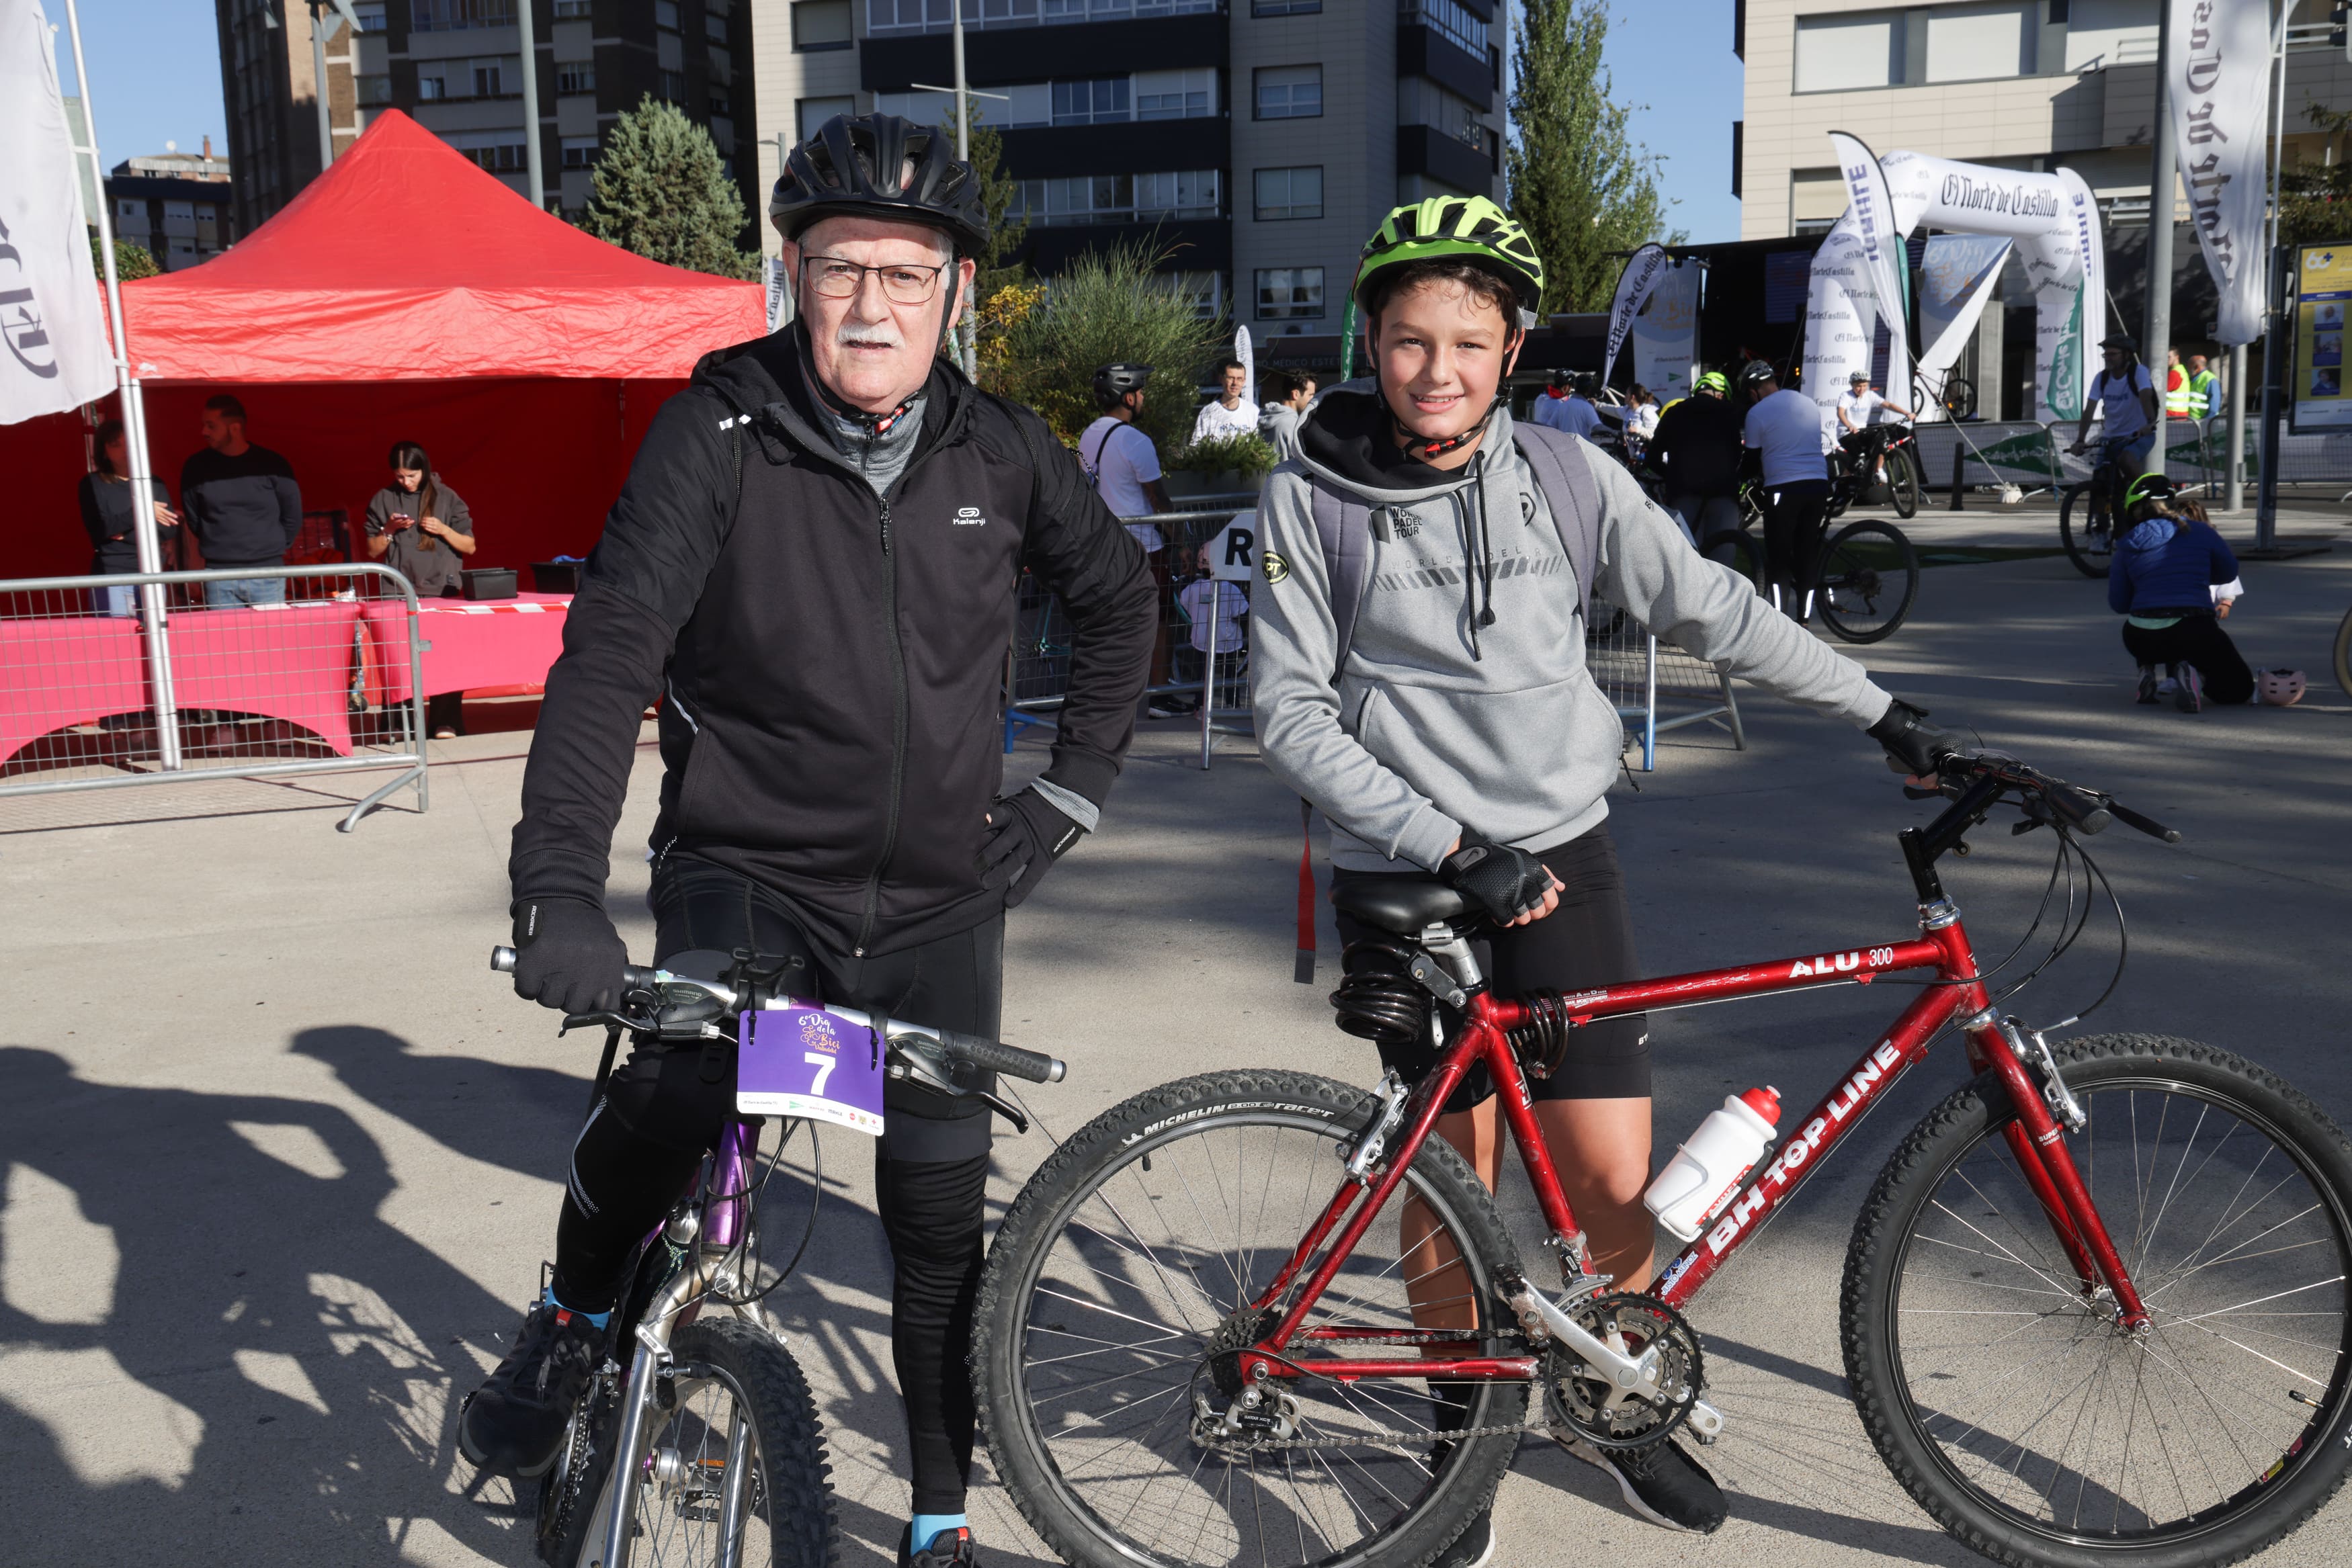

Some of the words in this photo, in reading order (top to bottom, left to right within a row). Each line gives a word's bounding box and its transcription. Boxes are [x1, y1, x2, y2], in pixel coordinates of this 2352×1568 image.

[1941, 173, 1959, 206] El
[1960, 175, 1996, 212] Norte
[1997, 184, 2011, 213] de
[2011, 185, 2058, 218] Castilla
[1612, 305, 1633, 337] Norte
[1625, 291, 1638, 306] de
[1633, 250, 1665, 293] Castilla
[953, 518, 986, 527] Kalenji
[1393, 517, 1423, 529] PADEL
[1394, 527, 1419, 539] TOUR
[1225, 528, 1254, 566] R
[1789, 952, 1859, 978] ALU
[1870, 947, 1893, 967] 300
[804, 1051, 836, 1096] 7
[1144, 1104, 1225, 1134] MICHELIN
[1706, 1184, 1766, 1256] BH
[1763, 1117, 1826, 1186] TOP
[1826, 1039, 1901, 1123] LINE
